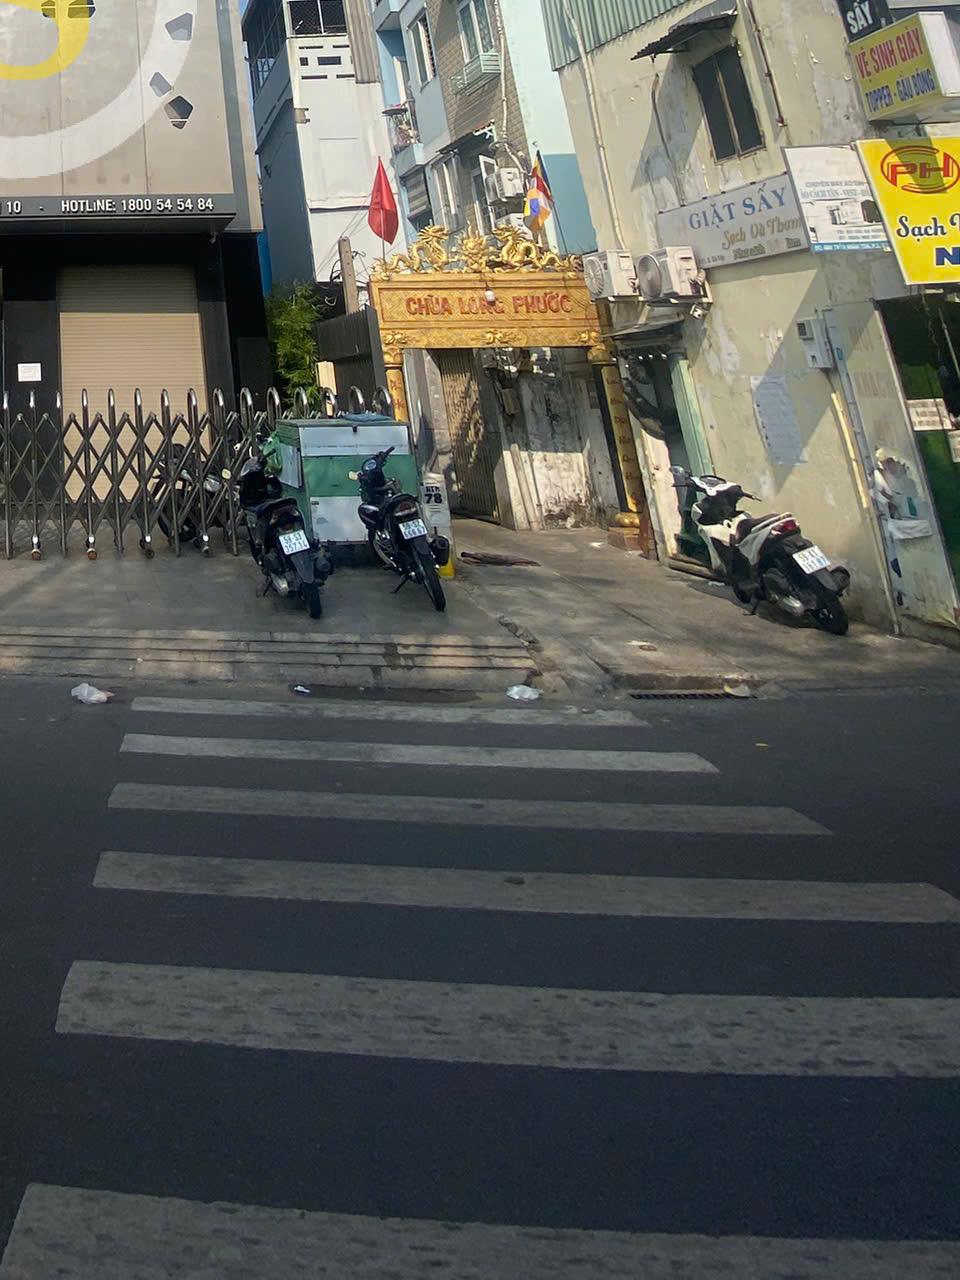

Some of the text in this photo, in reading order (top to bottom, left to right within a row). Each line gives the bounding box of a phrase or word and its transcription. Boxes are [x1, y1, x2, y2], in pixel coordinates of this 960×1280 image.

[870, 40, 898, 73] SINH
[6, 200, 21, 213] 10
[61, 199, 116, 213] HOTLINE:
[121, 198, 152, 212] 1800
[156, 198, 173, 211] 54
[177, 198, 193, 211] 54
[197, 197, 214, 210] 84
[689, 182, 785, 230] GIẶT SẤY
[896, 216, 947, 241] Sạch
[406, 291, 572, 316] CHÙA LONG PHƯỚC
[424, 493, 443, 504] 78
